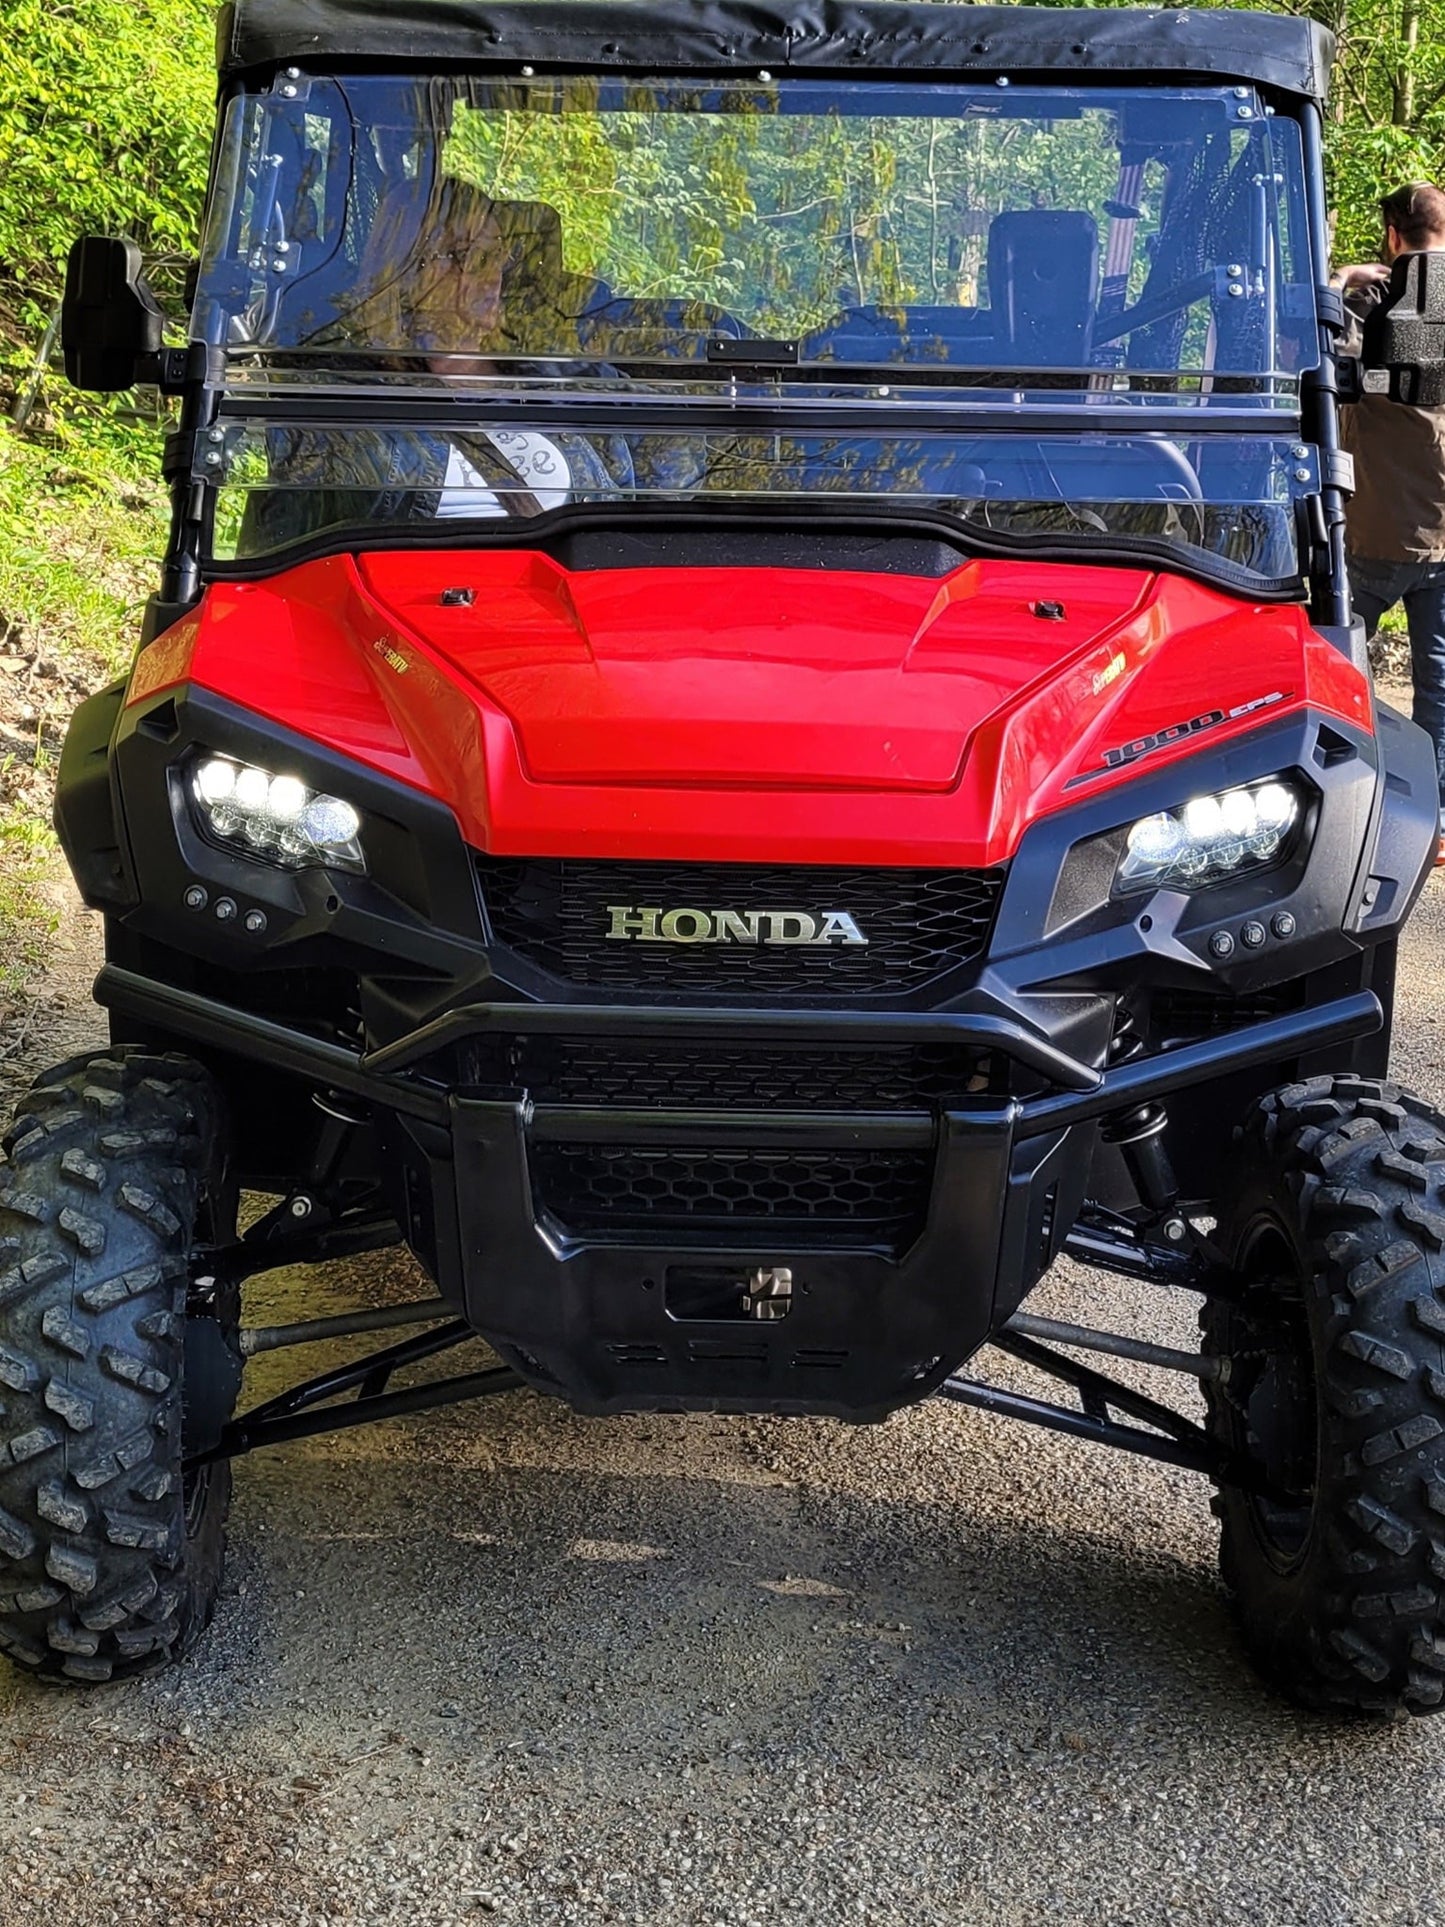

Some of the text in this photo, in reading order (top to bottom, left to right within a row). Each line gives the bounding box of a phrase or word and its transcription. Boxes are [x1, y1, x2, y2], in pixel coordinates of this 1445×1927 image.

[1102, 691, 1285, 768] 1000 EPS
[605, 906, 870, 946] HONDA
